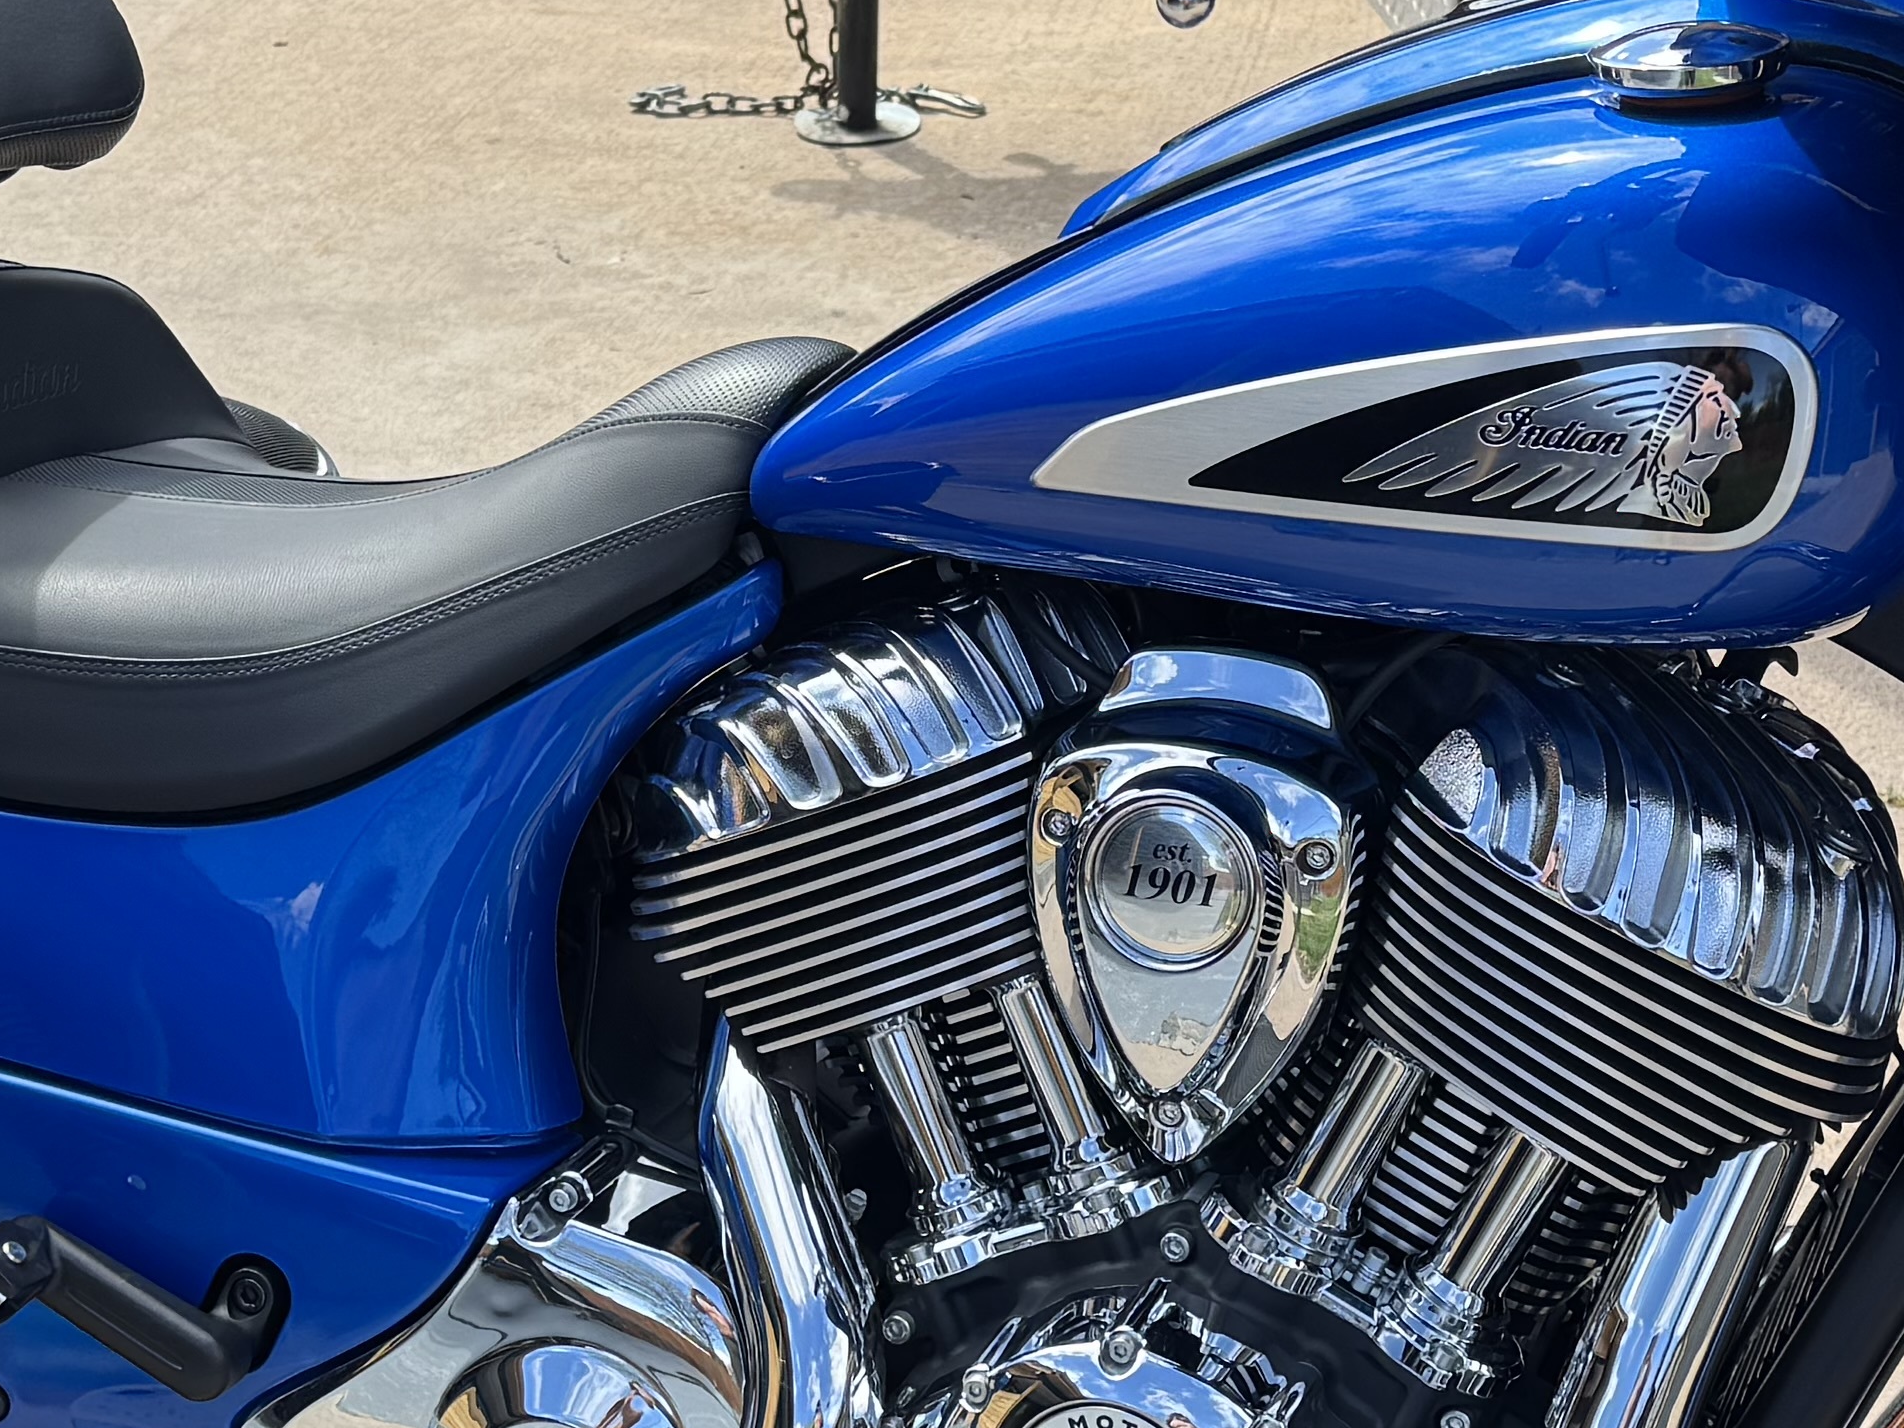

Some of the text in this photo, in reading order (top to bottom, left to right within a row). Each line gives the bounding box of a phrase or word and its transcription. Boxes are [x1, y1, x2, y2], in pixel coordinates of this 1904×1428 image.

[1477, 404, 1629, 457] Indian
[1152, 840, 1192, 864] est.
[1122, 862, 1219, 908] 1901
